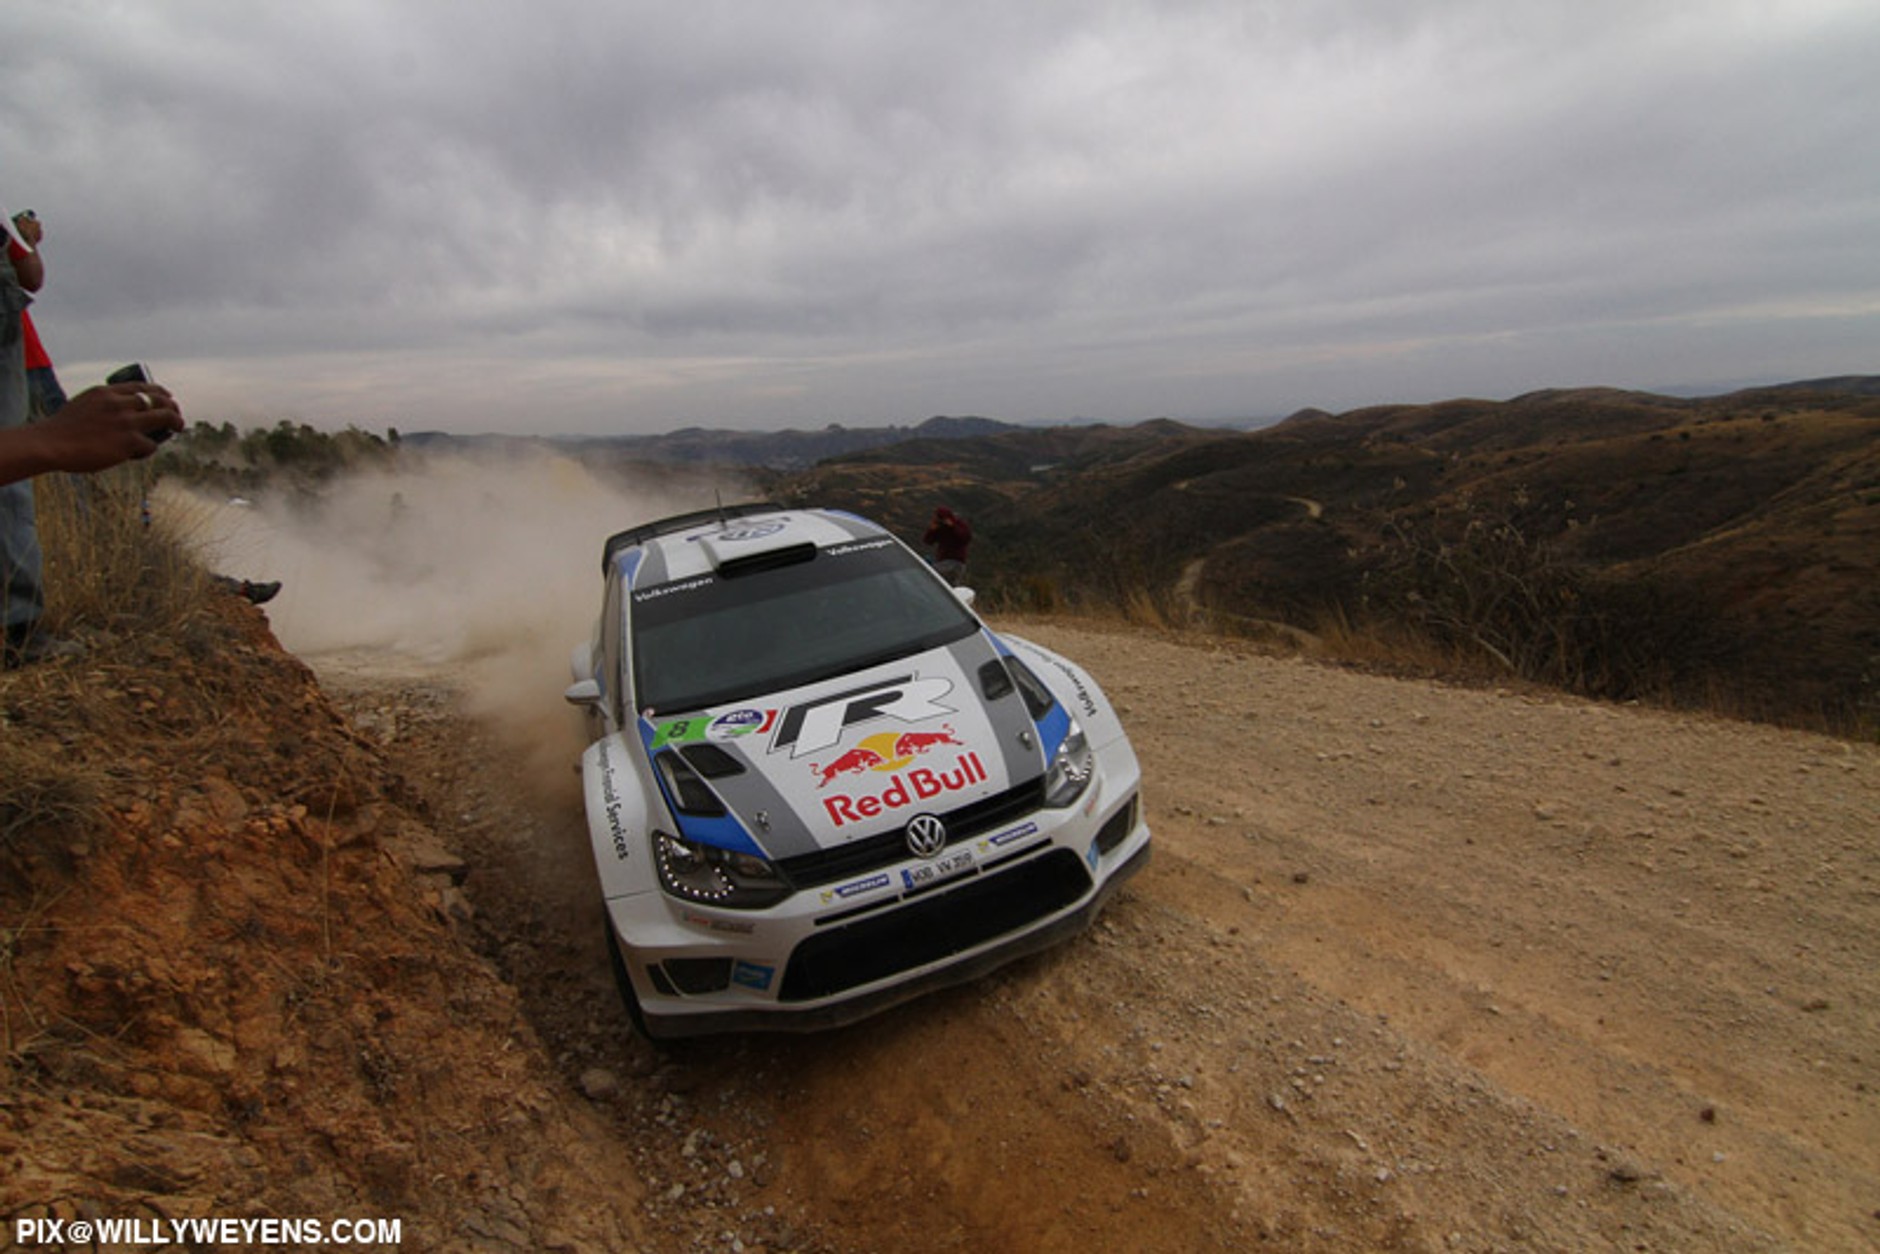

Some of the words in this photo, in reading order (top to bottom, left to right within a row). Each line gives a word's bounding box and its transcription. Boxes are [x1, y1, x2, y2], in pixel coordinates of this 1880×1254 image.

[634, 577, 714, 602] Volkswagen
[667, 720, 690, 738] 8
[822, 774, 911, 828] Red
[907, 751, 988, 800] Bull
[605, 803, 629, 860] Services
